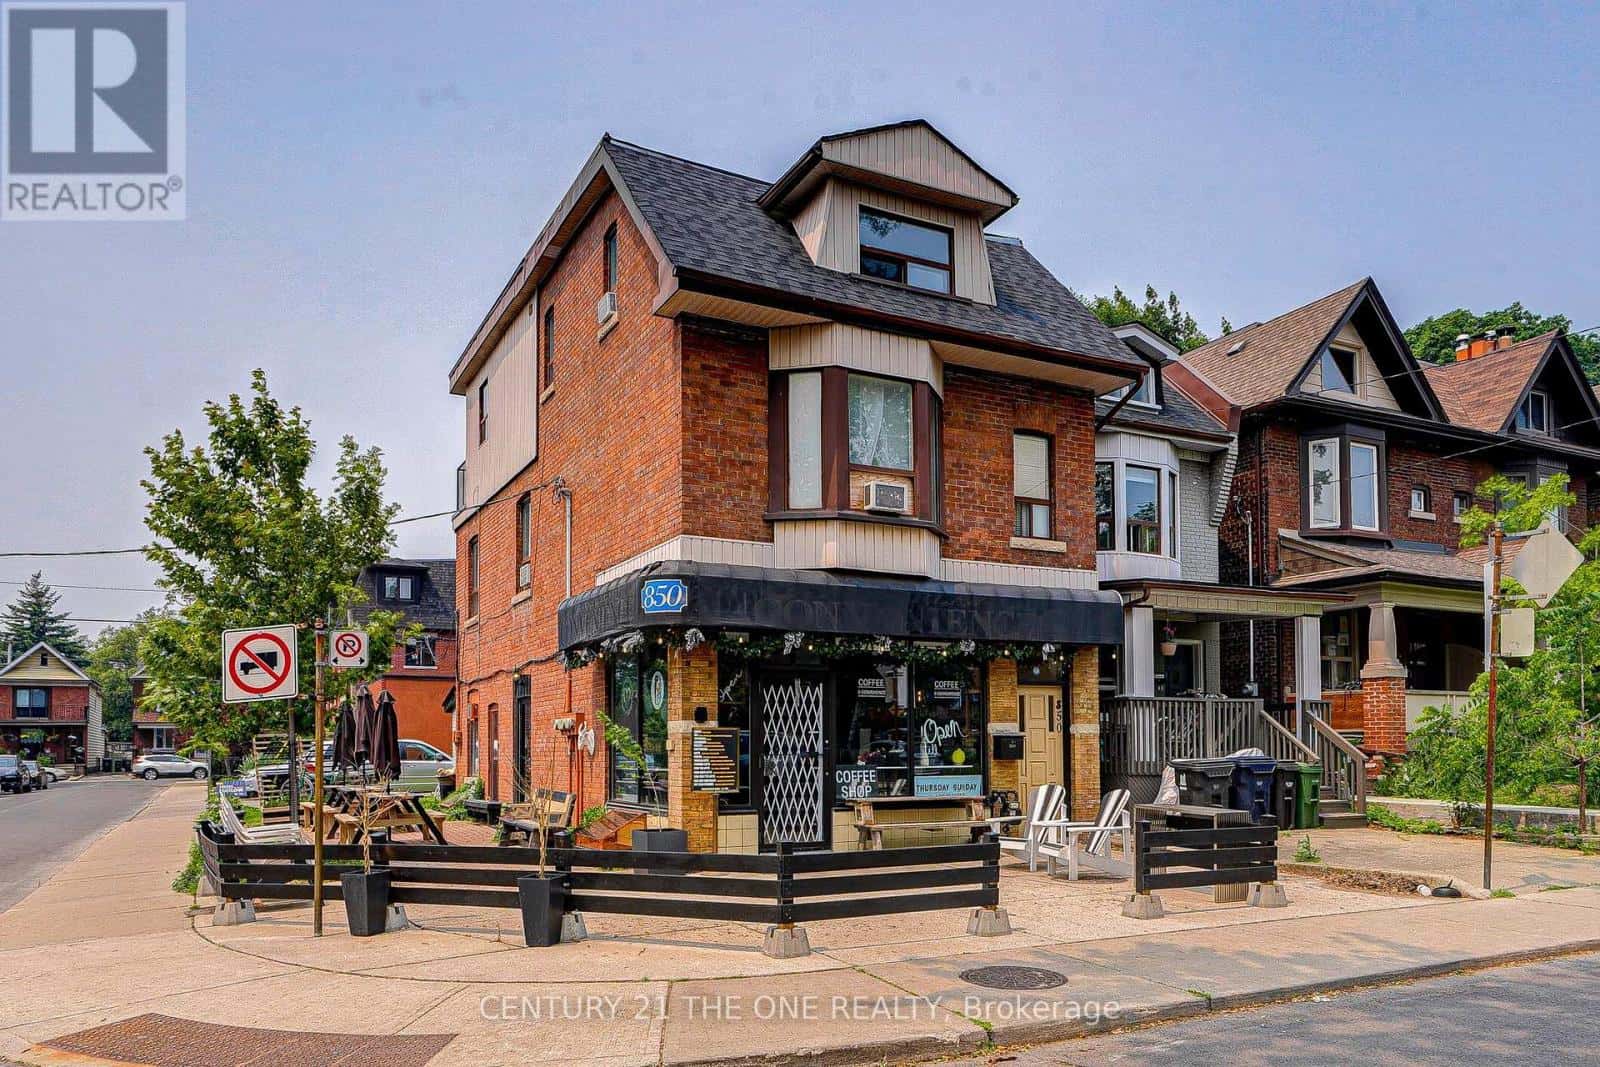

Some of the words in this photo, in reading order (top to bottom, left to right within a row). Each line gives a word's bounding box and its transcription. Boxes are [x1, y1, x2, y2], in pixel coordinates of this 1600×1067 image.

[643, 584, 683, 609] 850
[858, 678, 885, 687] COFFEE
[934, 680, 959, 689] COFFEE
[923, 718, 968, 746] Open
[835, 769, 876, 784] COFFEE
[841, 785, 872, 798] SHOP
[916, 784, 950, 793] THURSDAY
